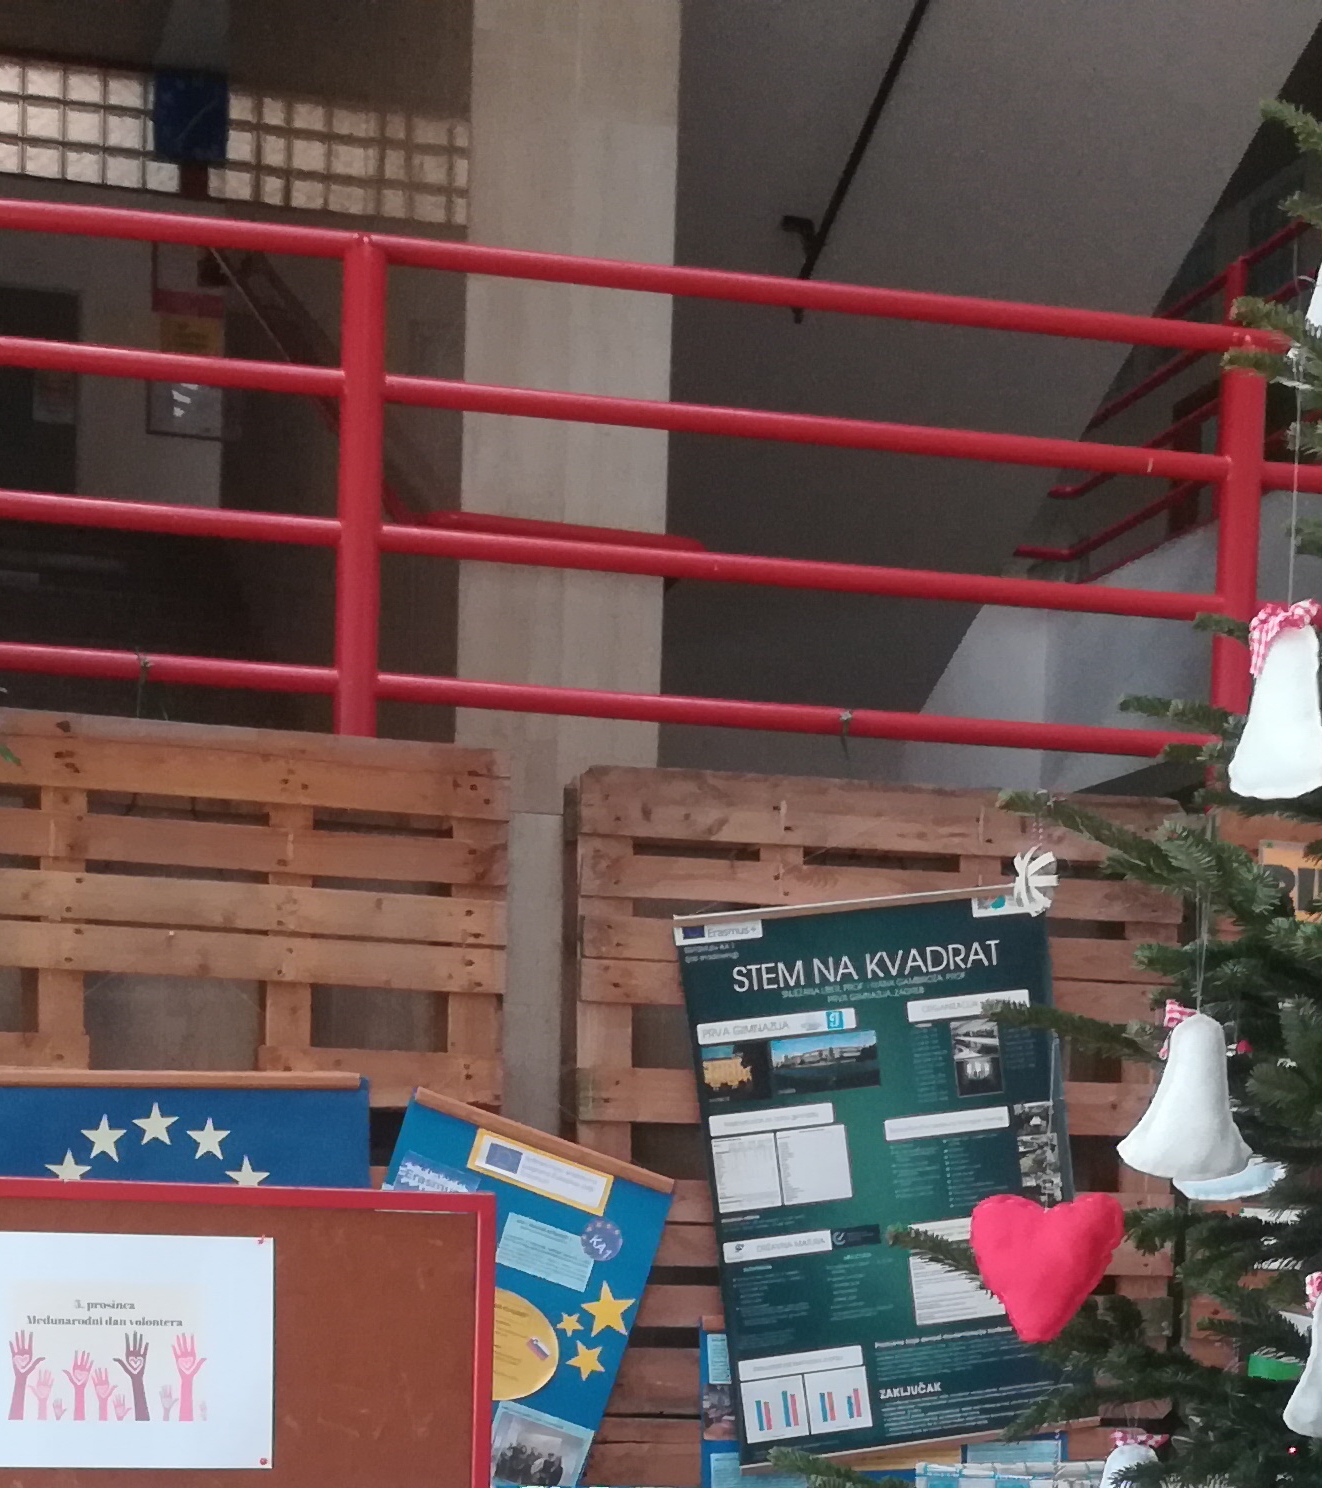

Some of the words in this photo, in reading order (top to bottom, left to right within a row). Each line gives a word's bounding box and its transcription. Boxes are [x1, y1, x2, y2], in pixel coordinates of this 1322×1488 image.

[732, 961, 805, 993] STEM
[813, 955, 858, 984] NA
[865, 940, 1000, 979] KVADRAT
[590, 1235, 612, 1259] KA1
[86, 1300, 136, 1311] prosinca
[105, 1316, 126, 1326] dan
[129, 1316, 183, 1327] volontera
[879, 1382, 942, 1399] ZAKLJUČAK
